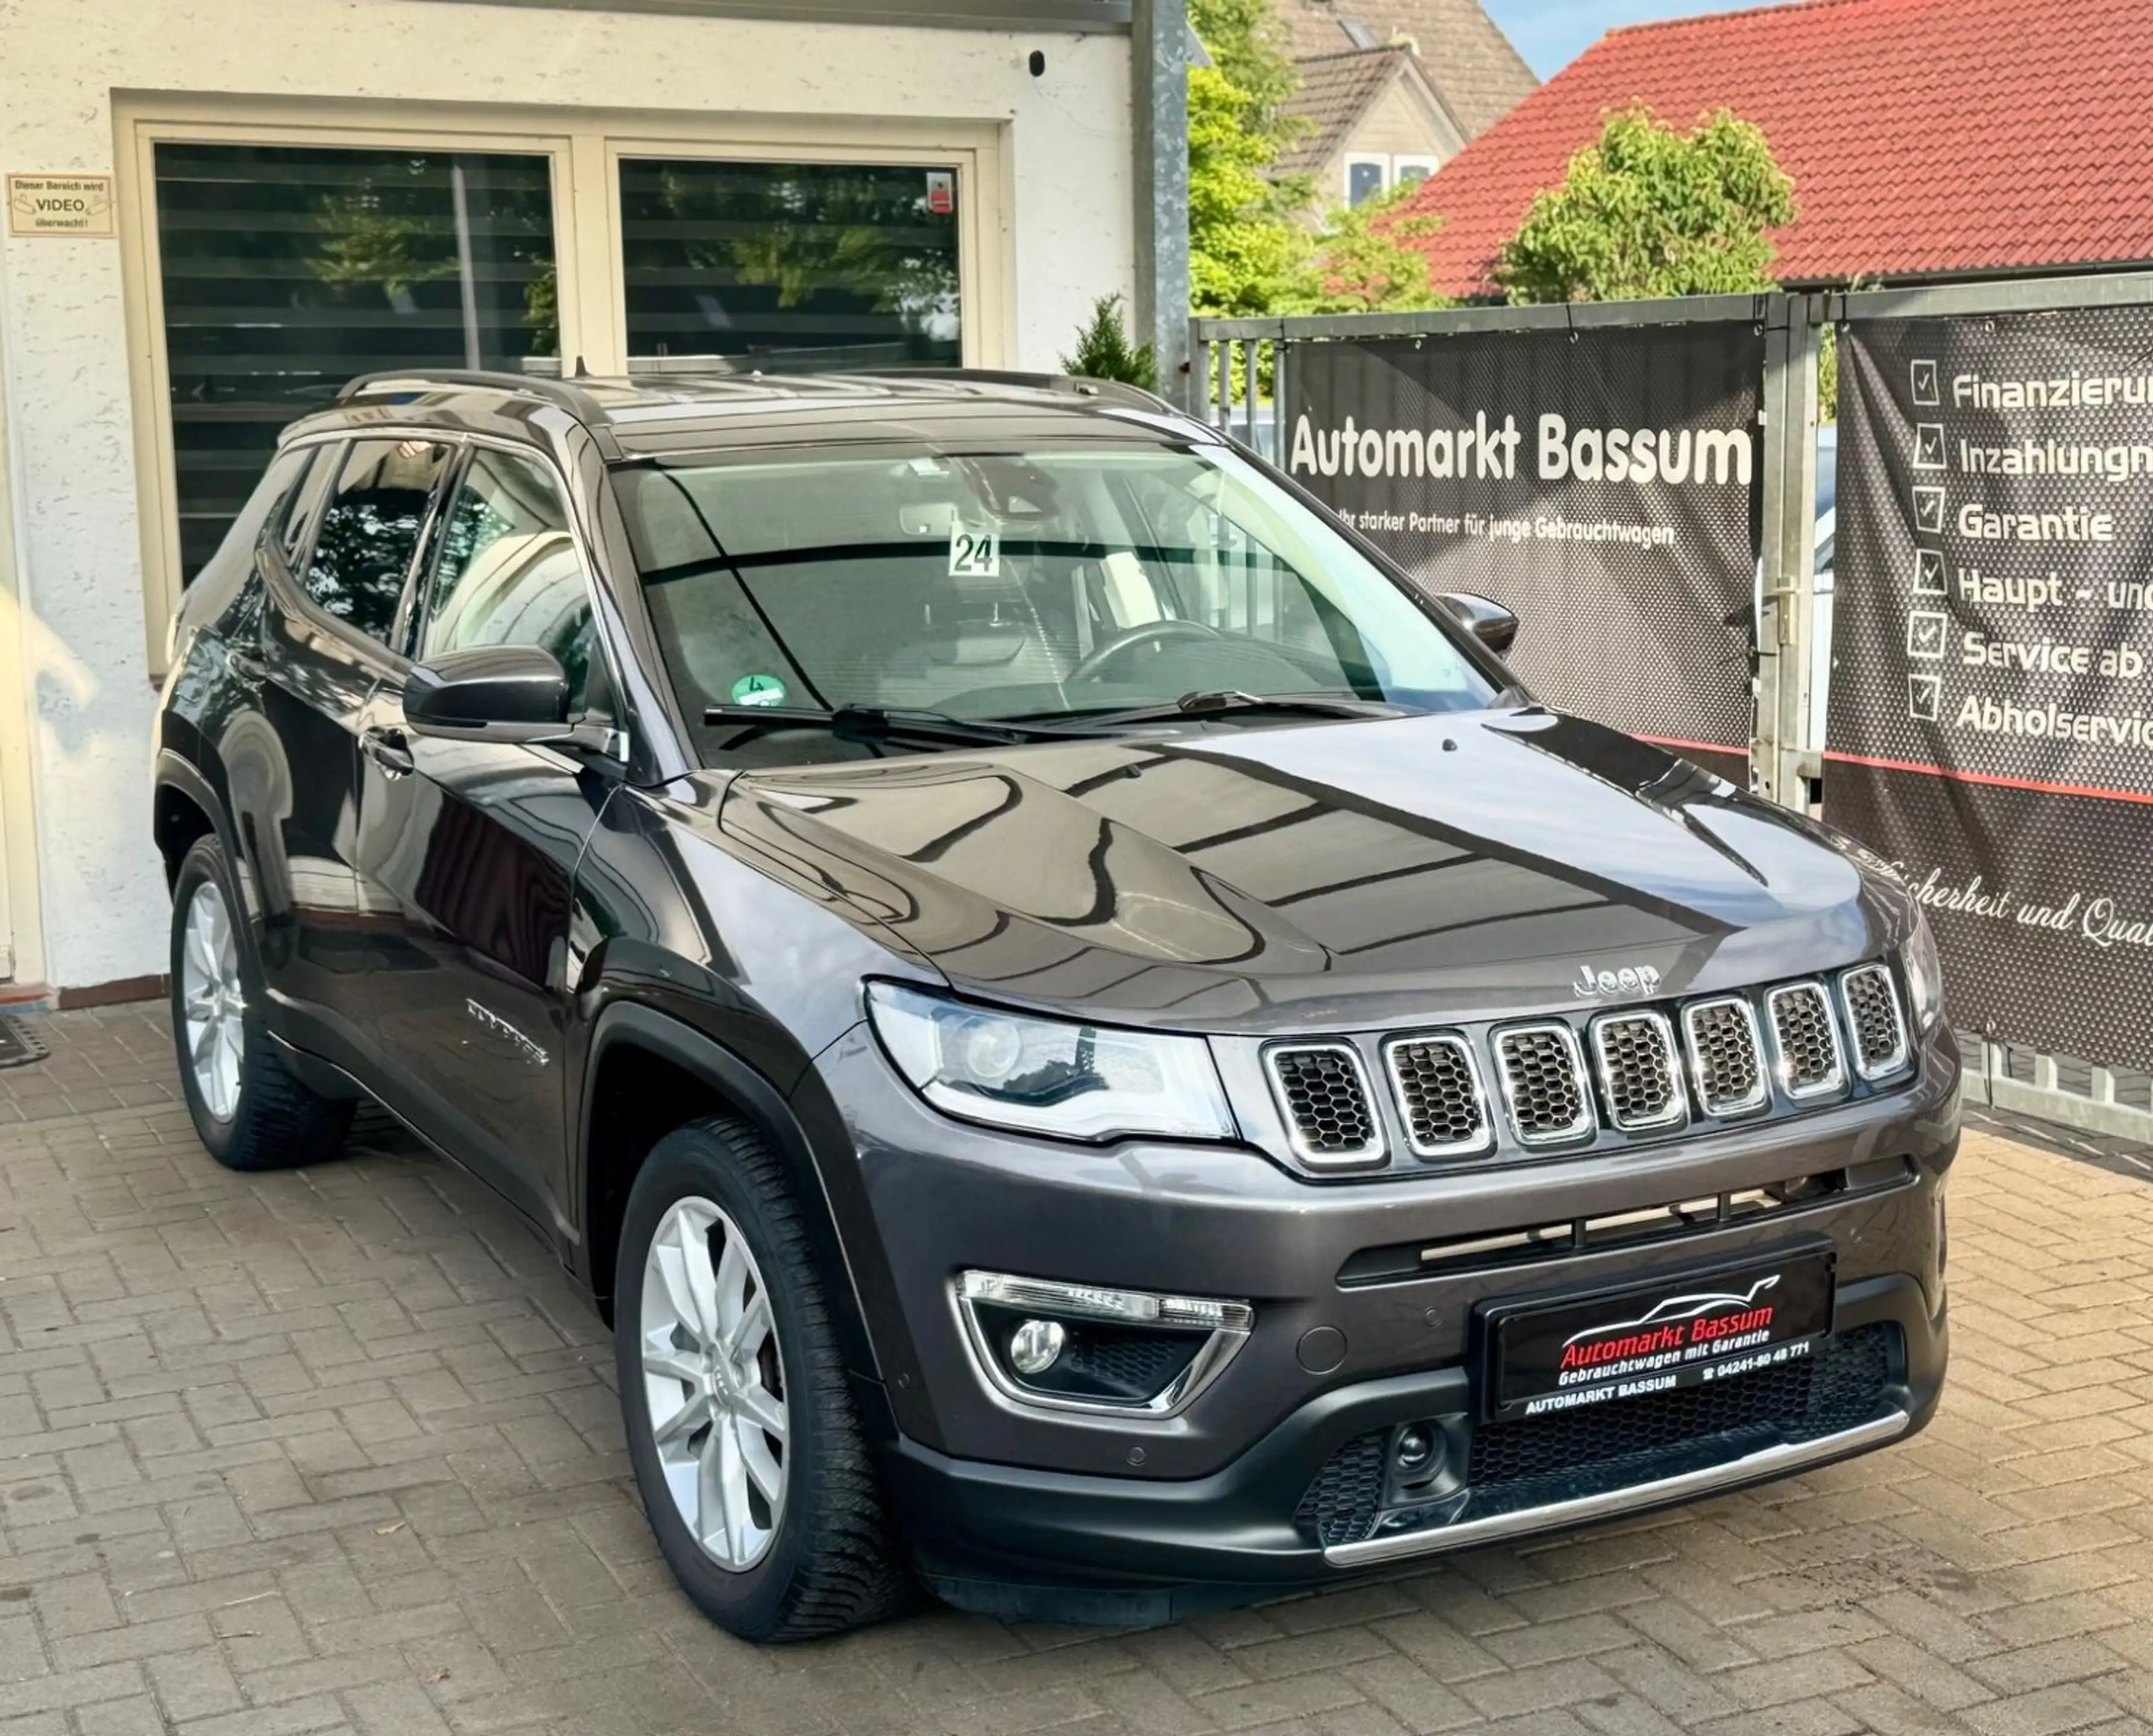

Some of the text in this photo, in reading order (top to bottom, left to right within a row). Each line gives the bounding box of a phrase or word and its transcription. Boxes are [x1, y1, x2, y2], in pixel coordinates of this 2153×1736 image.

[15, 180, 43, 189] Dieser
[46, 181, 81, 190] Bereich
[36, 199, 84, 211] VIDEO
[1953, 370, 2153, 409] Finanzieru
[1290, 410, 1752, 485] Automarkt Bassum
[1960, 439, 2153, 482] Inzahlungn
[1360, 511, 1405, 531] starker
[1409, 512, 1460, 533] Partner
[1464, 513, 1485, 535] für
[1490, 514, 1531, 542] junge
[1536, 514, 1675, 549] Gebrauchtwagen
[1959, 503, 2111, 541] Garantie
[954, 534, 993, 572] 24
[1958, 568, 2062, 612] Haupt
[1963, 631, 2143, 678] Service ab
[1956, 695, 2153, 747] Abholservic
[2017, 893, 2081, 930] und
[1574, 965, 1660, 997] Jeep
[1559, 1329, 1770, 1386] Gebrauchtwagen mit Garantie
[1560, 1306, 1773, 1369] Automarkt Bassum
[1525, 1374, 1677, 1415] AUTOMARKT BASSUM
